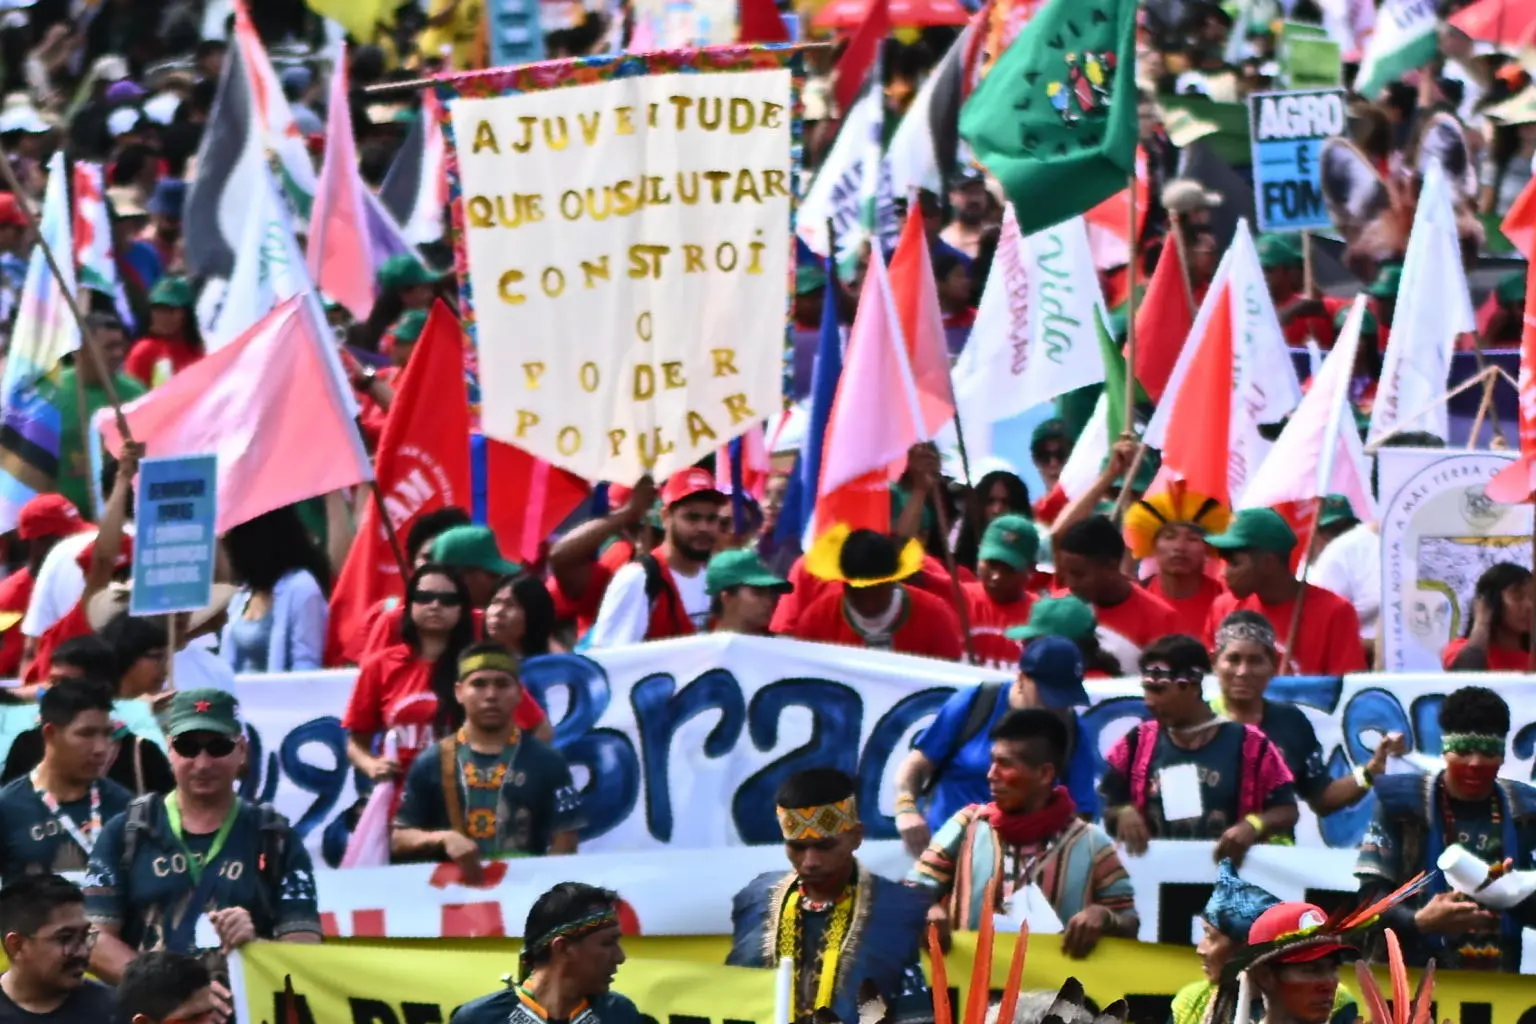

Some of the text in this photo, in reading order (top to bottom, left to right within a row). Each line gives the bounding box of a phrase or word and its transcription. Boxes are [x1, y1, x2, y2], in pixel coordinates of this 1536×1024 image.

[472, 119, 501, 154] A
[1258, 94, 1344, 139] AGRO
[467, 193, 545, 229] QUE
[646, 168, 790, 206] LUTAR
[1263, 179, 1323, 220] FOM
[636, 312, 654, 342] O
[521, 348, 739, 402] PODER
[516, 393, 755, 469] POPULAR
[1392, 541, 1402, 592] NOSSA
[1402, 484, 1429, 515] MÃE
[1432, 466, 1482, 486] TERRA
[30, 821, 62, 841] CO
